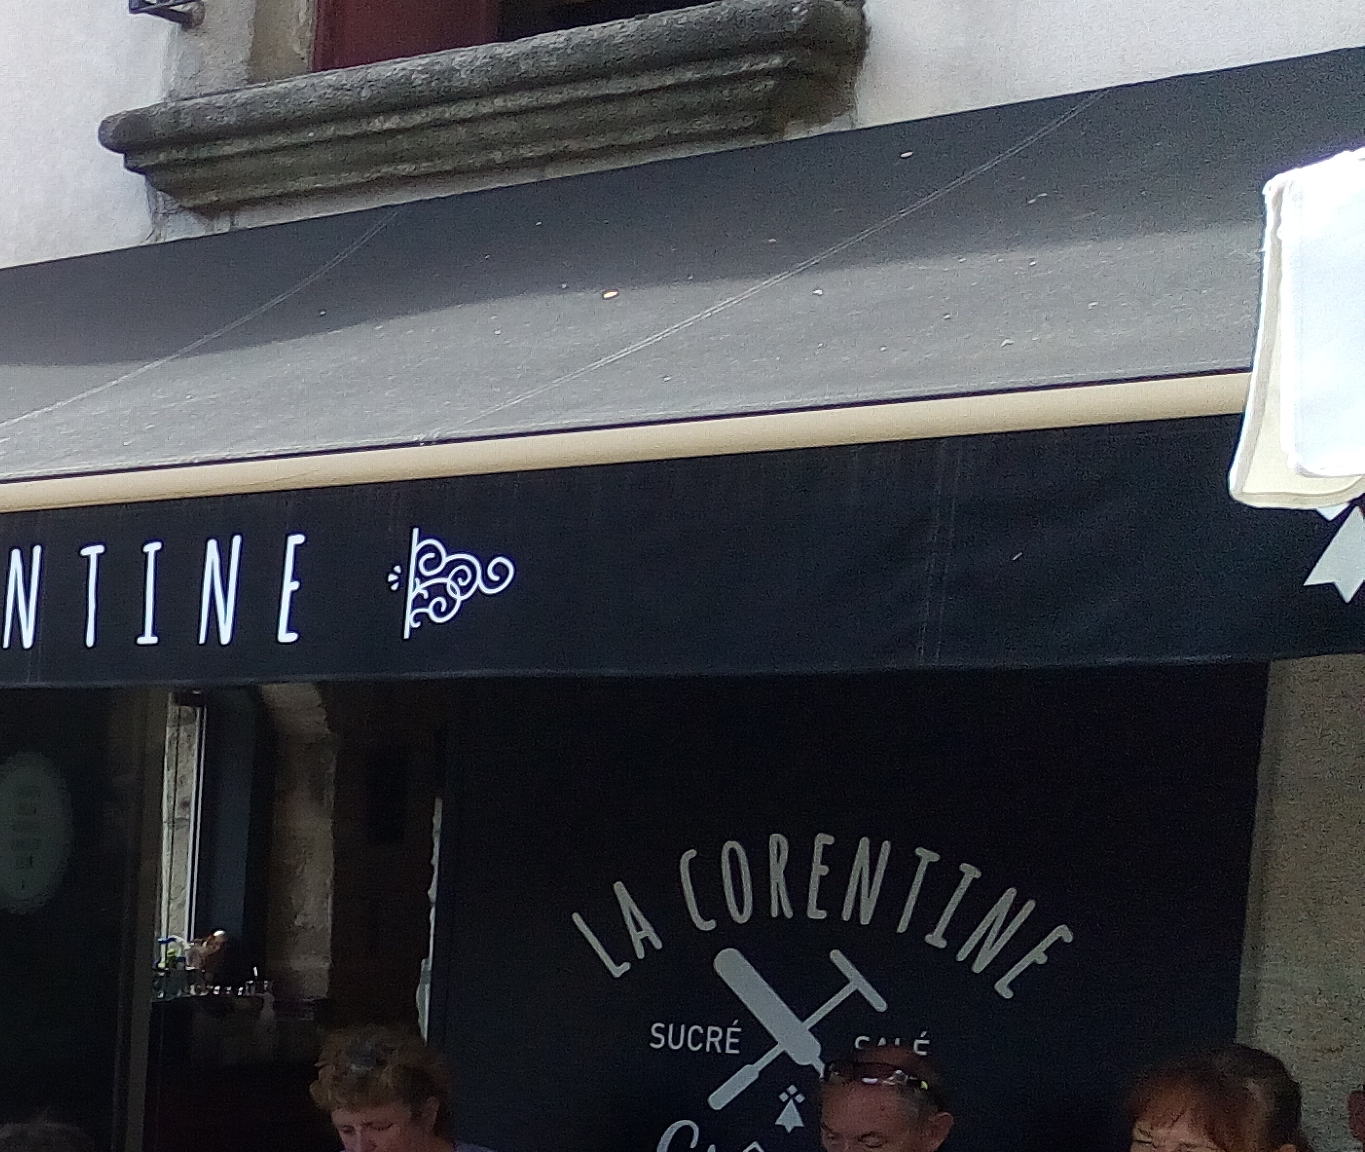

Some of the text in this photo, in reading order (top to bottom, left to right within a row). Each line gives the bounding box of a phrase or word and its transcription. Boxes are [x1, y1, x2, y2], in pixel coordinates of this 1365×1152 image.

[570, 831, 1075, 1000] LA CORENTINE
[648, 1019, 743, 1056] SUCRÉ
